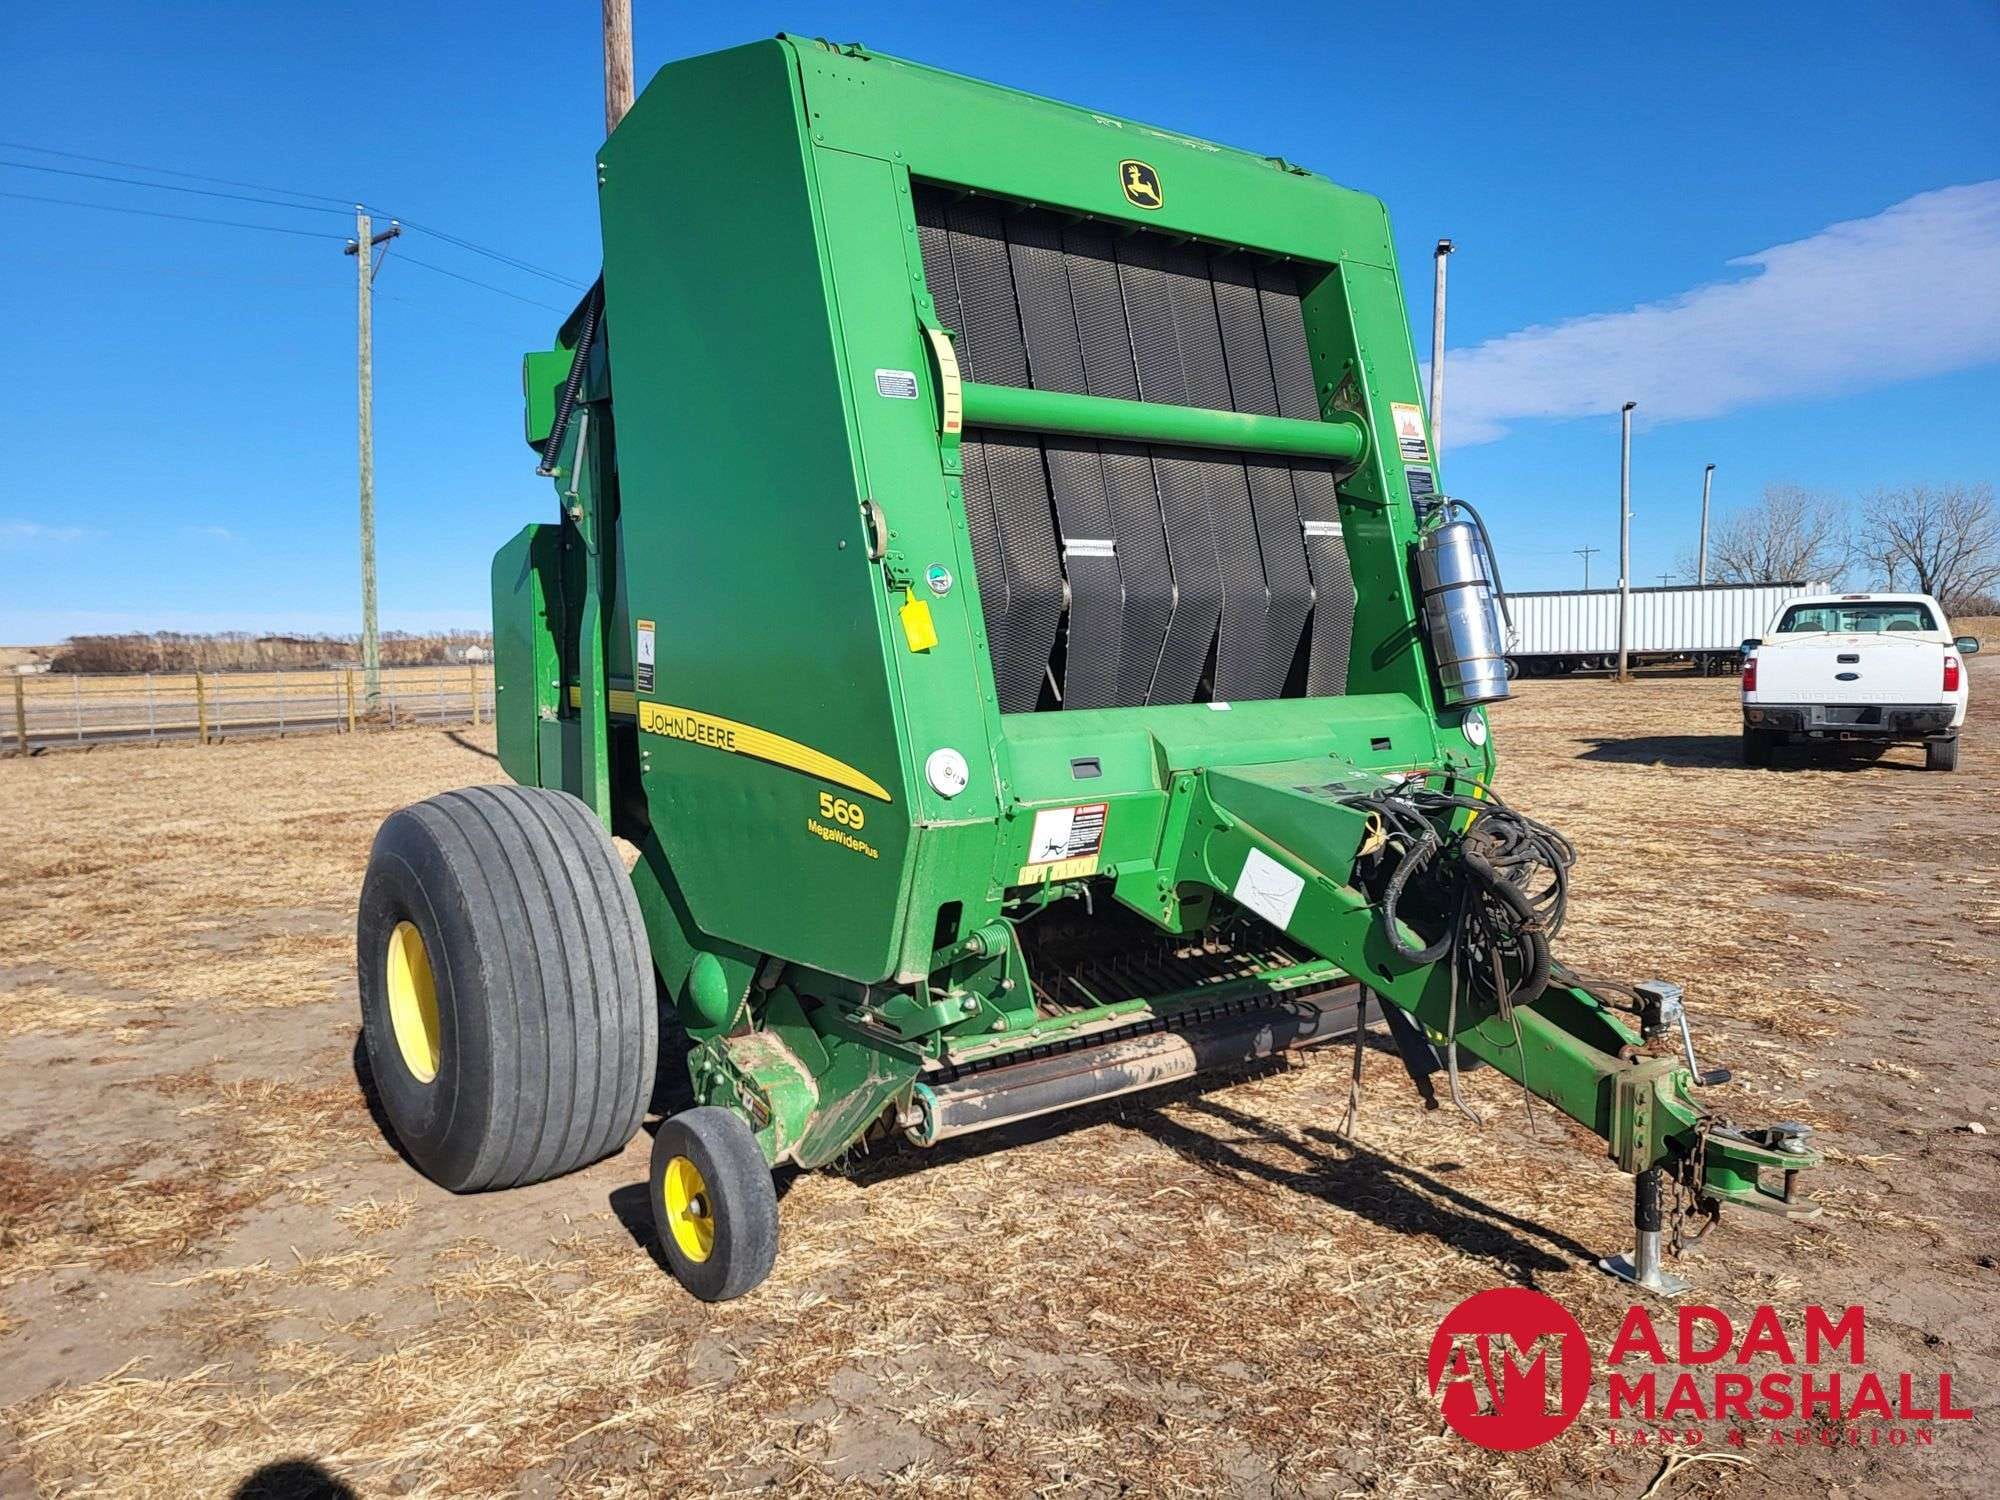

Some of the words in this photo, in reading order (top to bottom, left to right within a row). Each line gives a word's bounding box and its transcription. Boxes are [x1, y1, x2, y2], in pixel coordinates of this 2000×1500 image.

[648, 710, 685, 736] JOHN
[686, 717, 736, 749] DEERE
[819, 791, 865, 831] 569
[807, 817, 880, 860] MegaWidePlus
